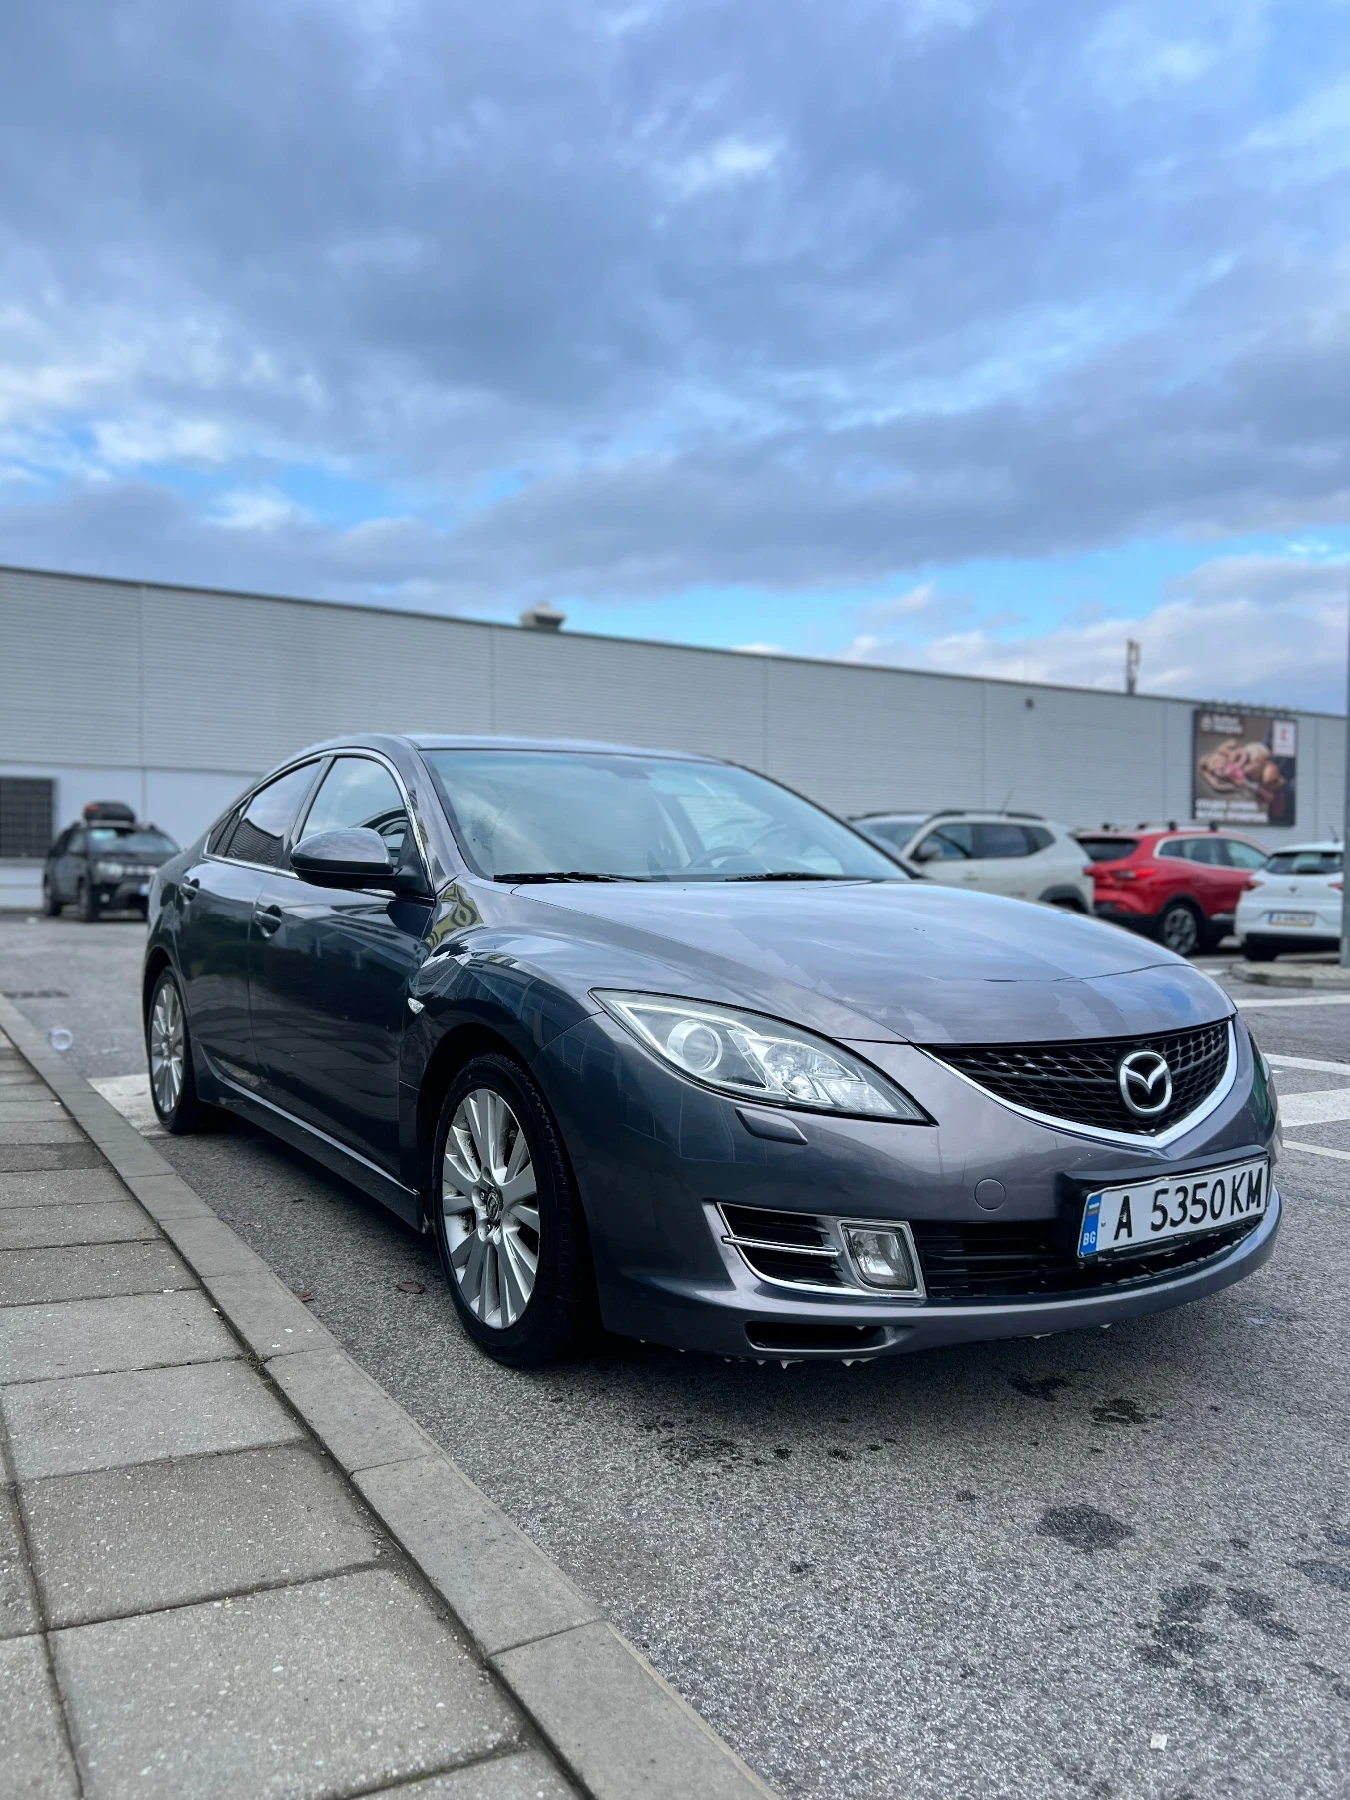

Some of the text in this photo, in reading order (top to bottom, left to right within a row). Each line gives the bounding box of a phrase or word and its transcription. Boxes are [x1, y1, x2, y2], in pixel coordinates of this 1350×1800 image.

[1113, 1167, 1263, 1241] A 5350 KM
[1082, 1231, 1096, 1246] BG
